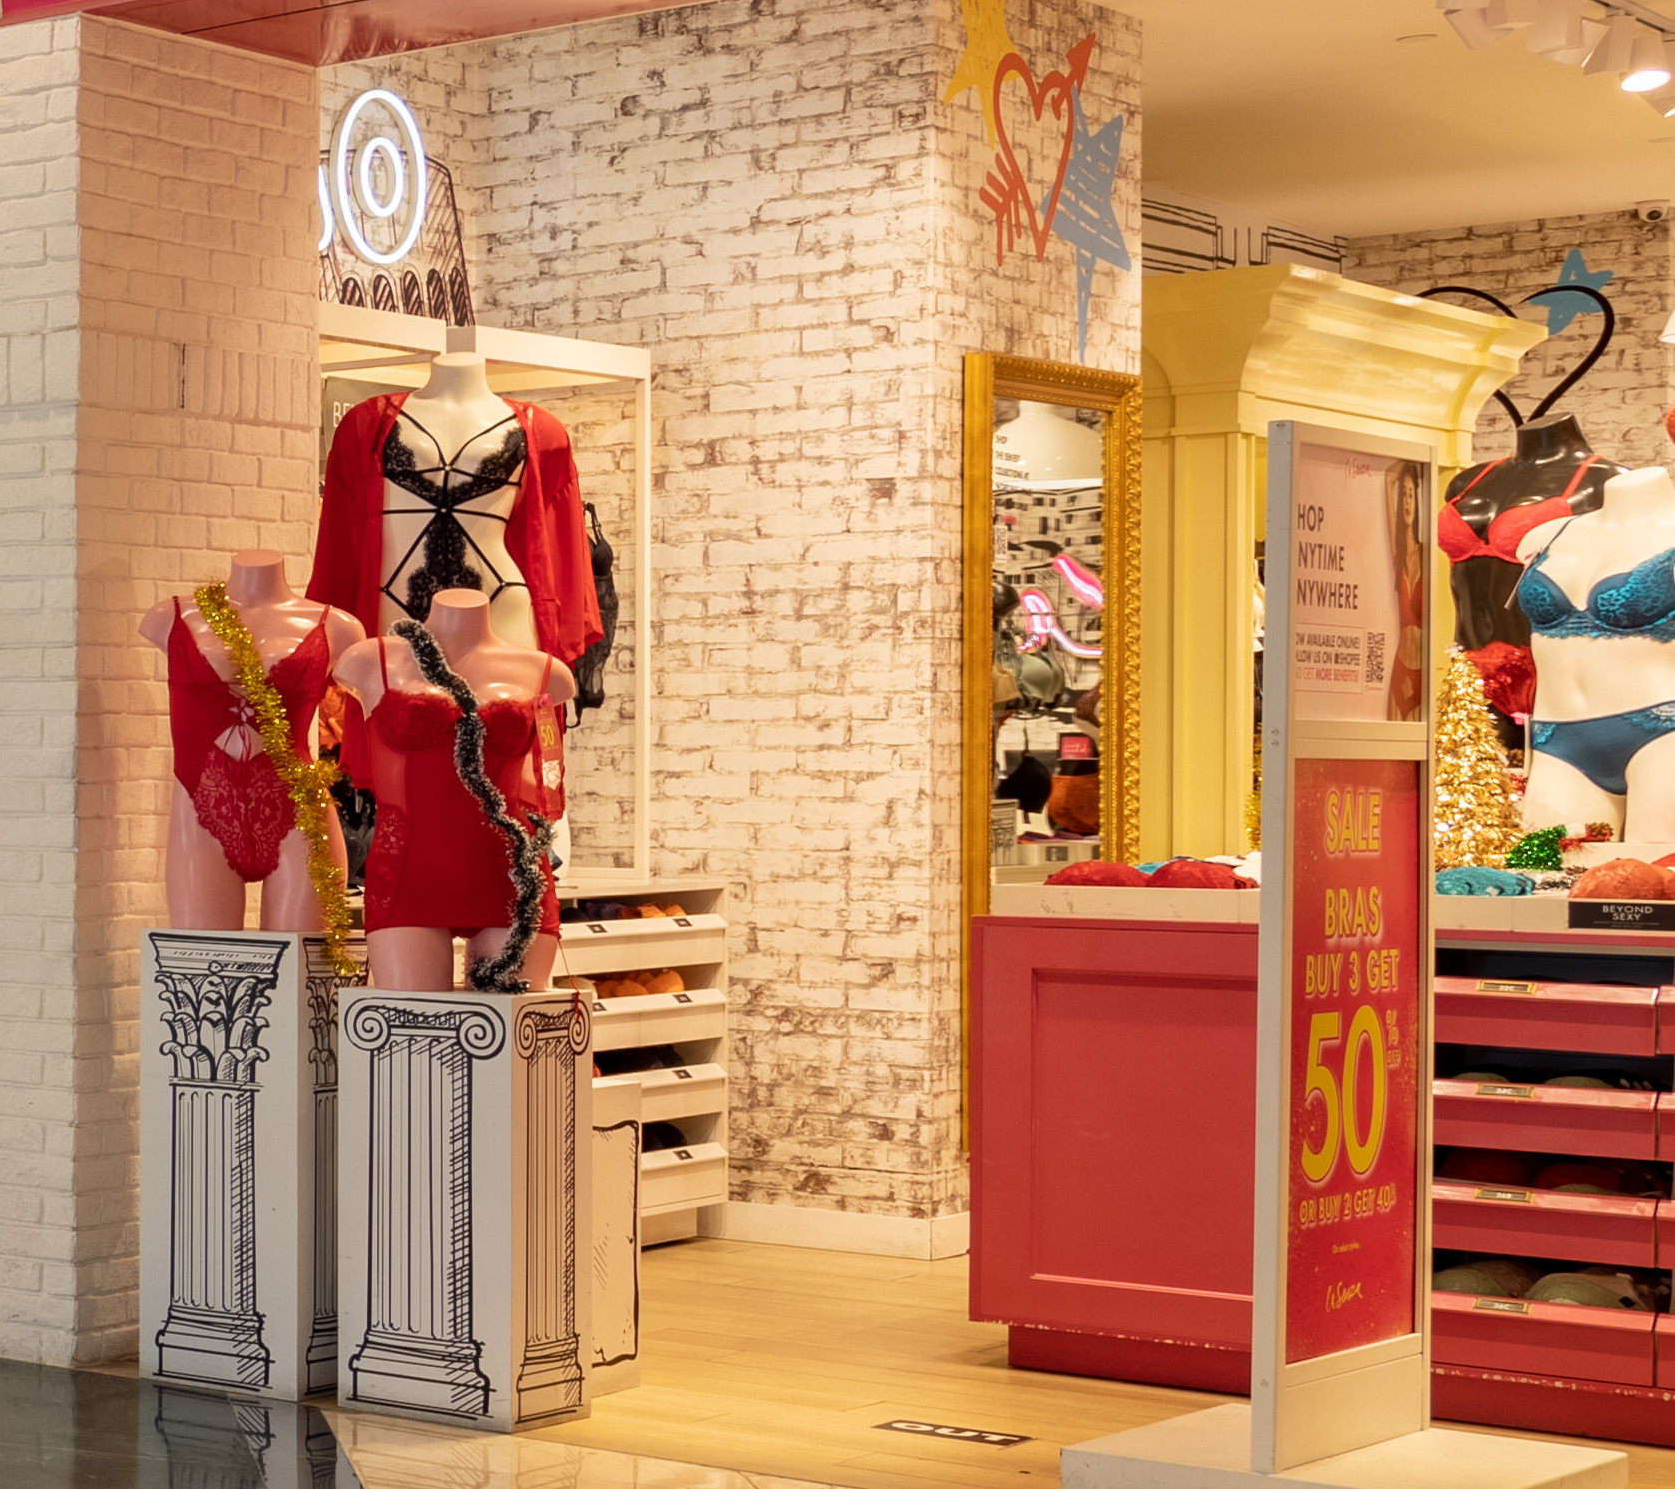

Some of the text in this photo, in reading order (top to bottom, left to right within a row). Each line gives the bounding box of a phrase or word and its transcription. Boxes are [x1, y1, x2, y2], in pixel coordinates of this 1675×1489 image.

[1306, 632, 1336, 649] AVAILABLE
[1312, 650, 1322, 664] US
[1322, 651, 1333, 665] ON
[1303, 668, 1315, 682] GET
[1315, 668, 1333, 683] MORE
[1326, 790, 1382, 854] SALE
[1325, 885, 1382, 937] BRAS
[1602, 904, 1654, 915] BEYOND
[1611, 912, 1643, 922] SEXY
[1305, 948, 1399, 995] BUY 3 GET
[1300, 1200, 1315, 1224] OR
[1319, 1195, 1340, 1221] BUY
[1343, 1193, 1351, 1215] 2
[1354, 1188, 1374, 1213] GET
[891, 1421, 1020, 1442] OUT
